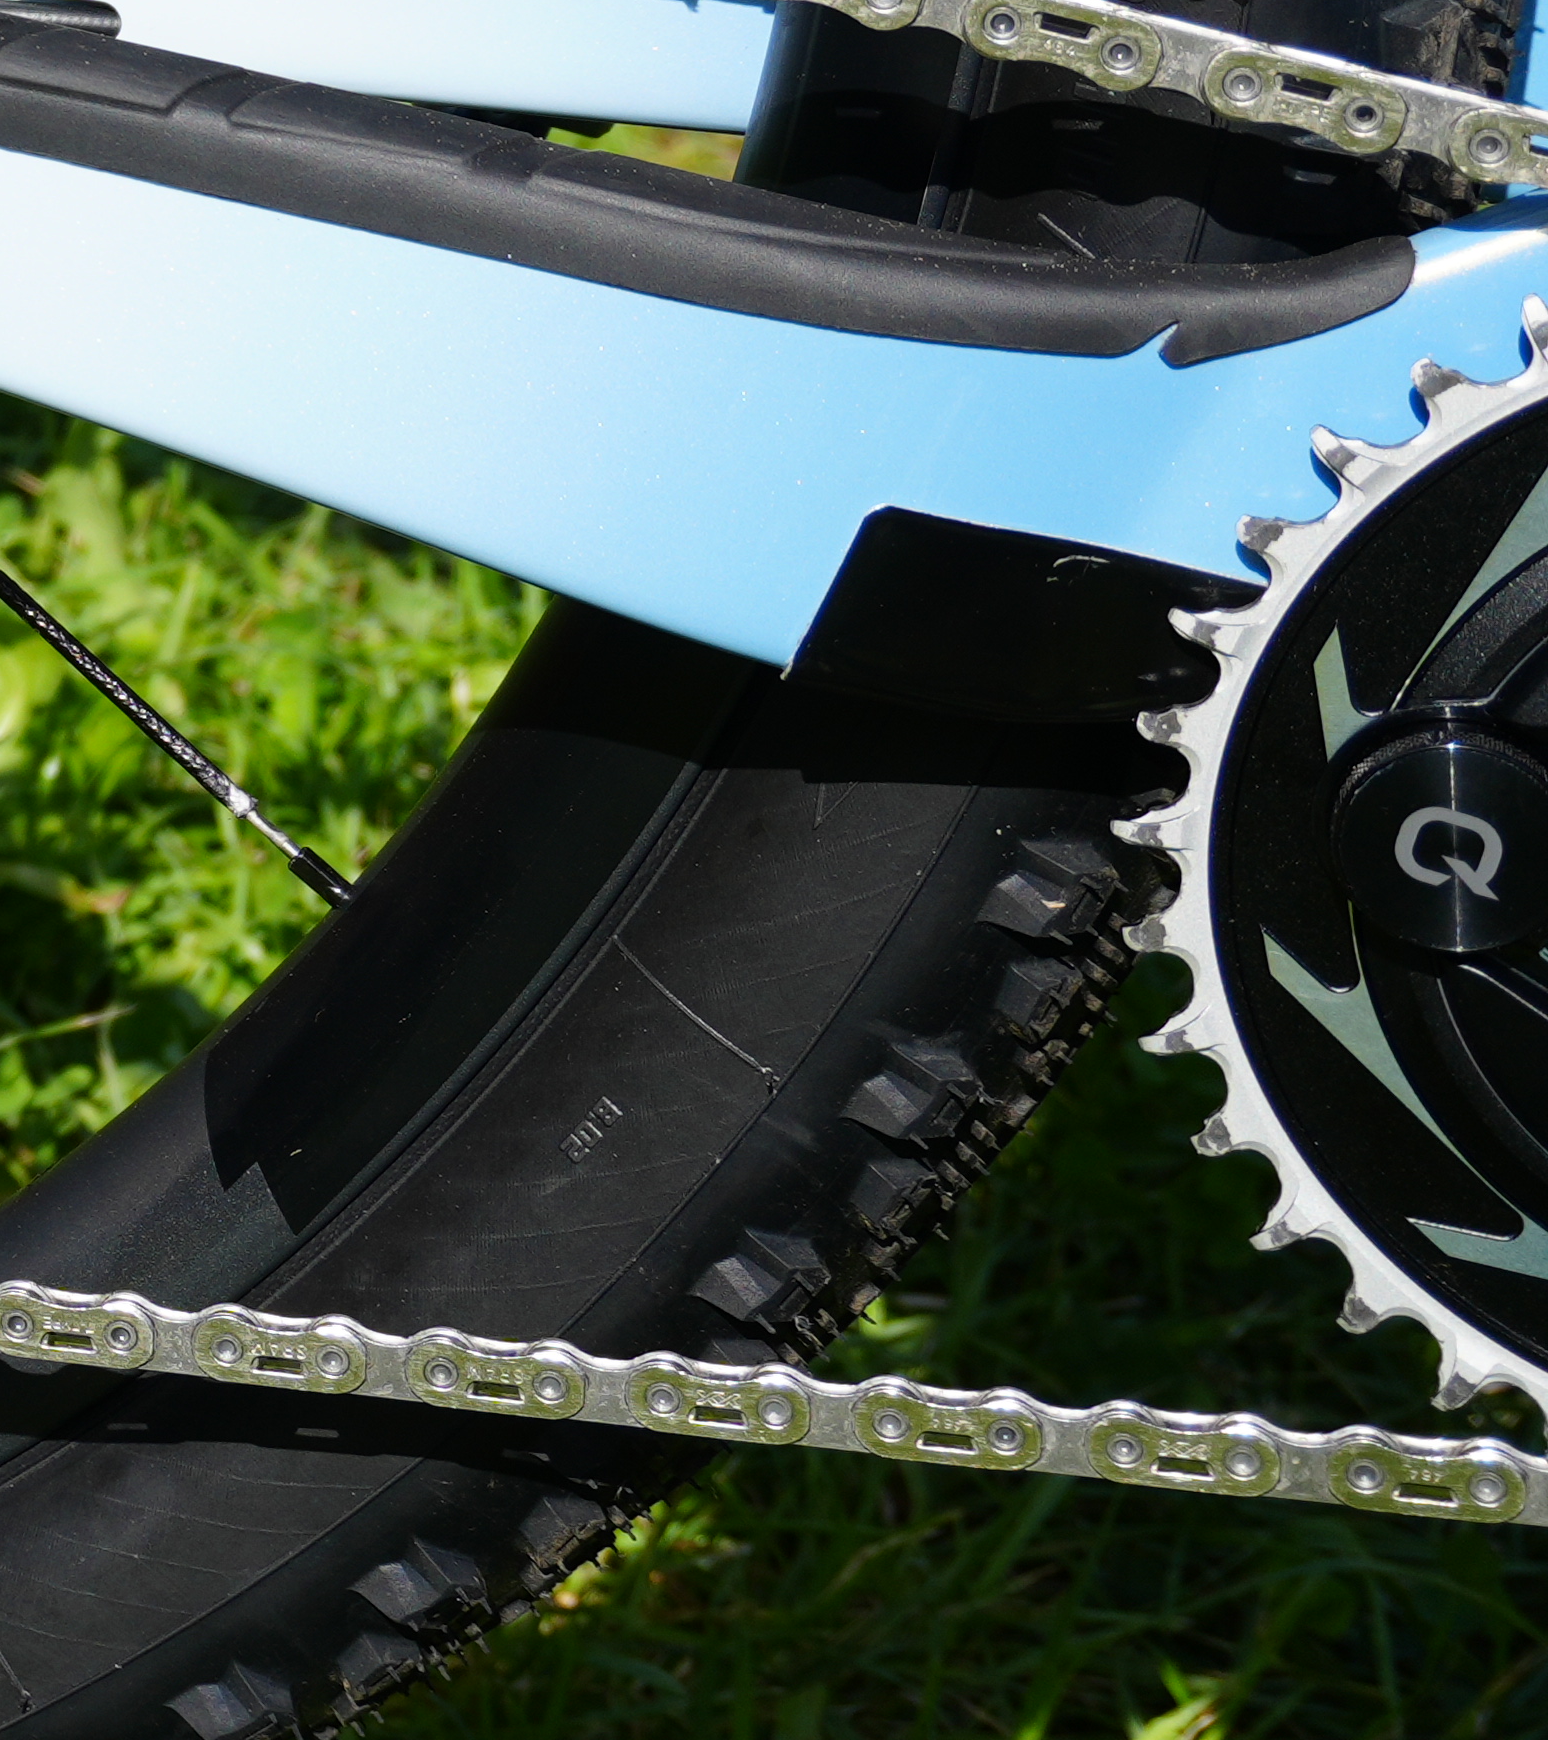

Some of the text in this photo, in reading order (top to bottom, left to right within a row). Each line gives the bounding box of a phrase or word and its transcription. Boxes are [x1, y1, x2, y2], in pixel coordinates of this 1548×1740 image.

[1393, 806, 1504, 901] Q
[248, 1337, 308, 1362] SRAM
[464, 1362, 525, 1385] SRAM
